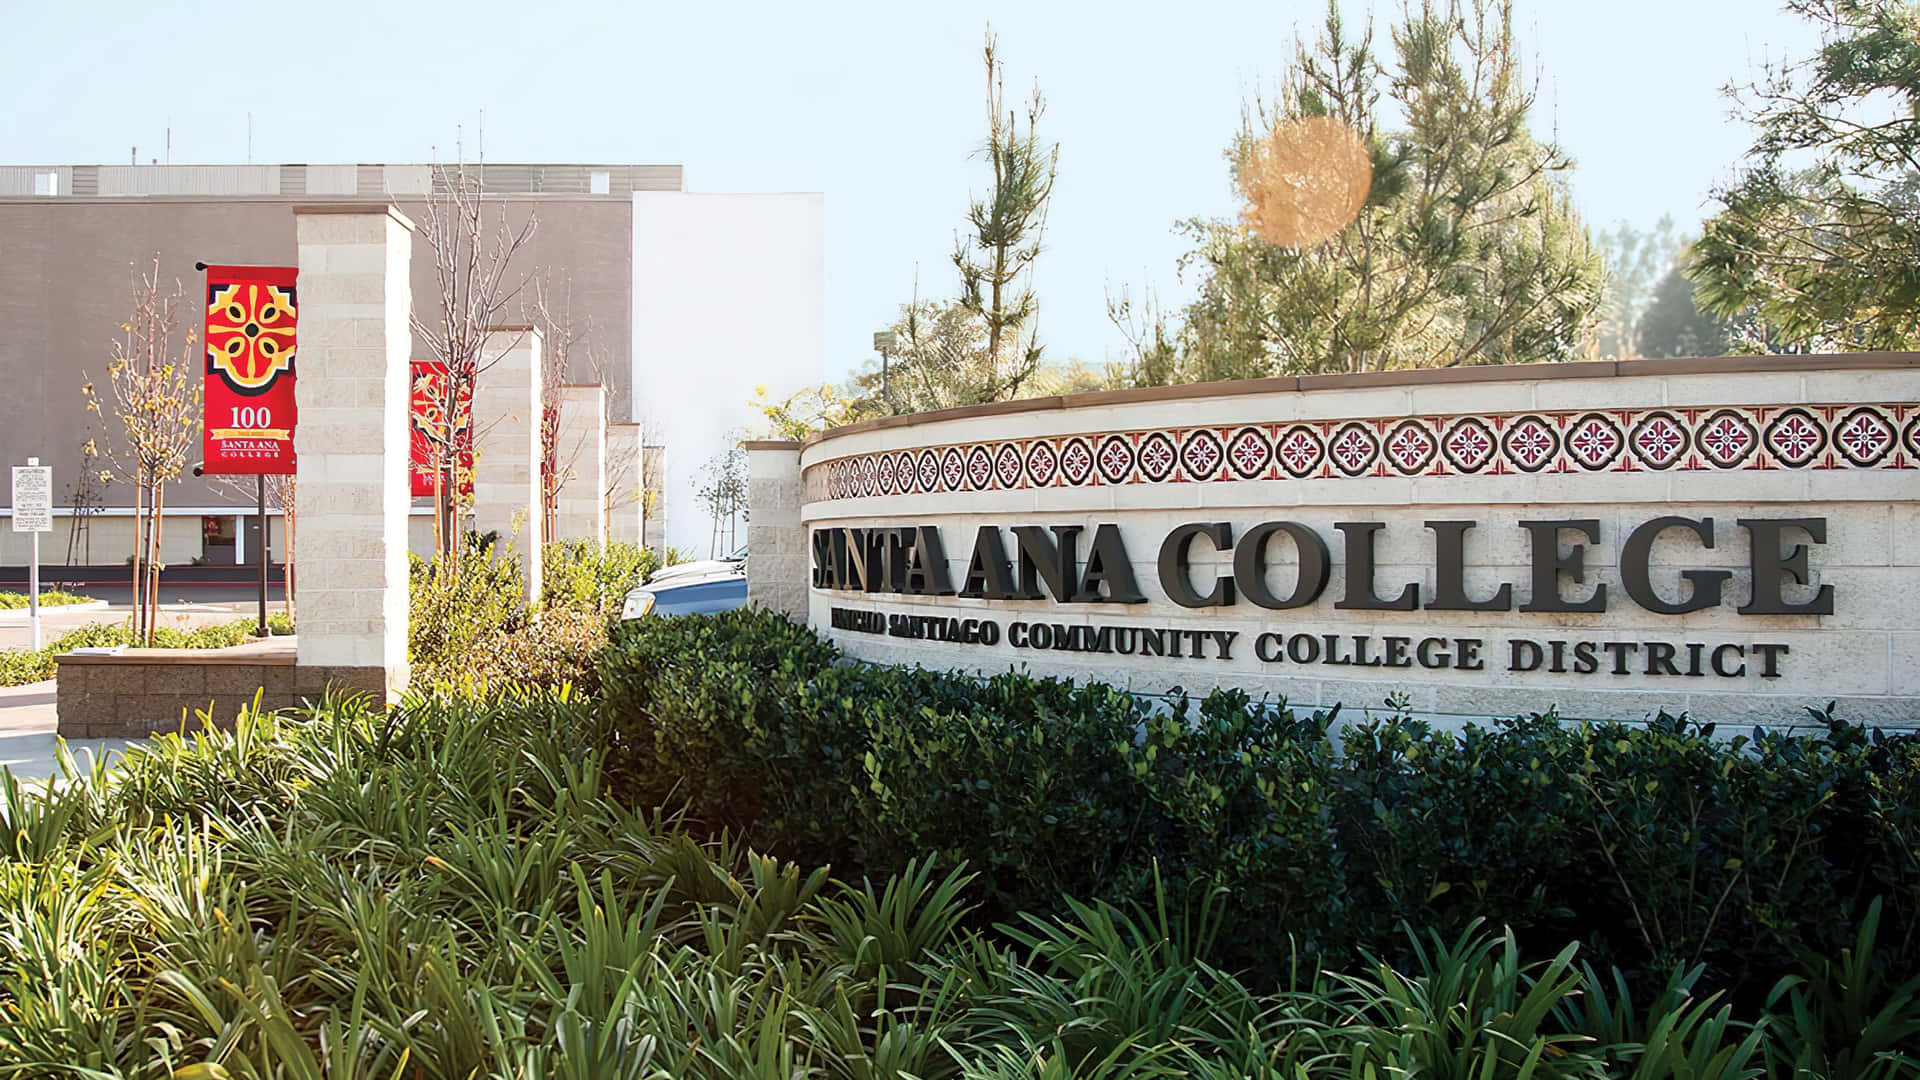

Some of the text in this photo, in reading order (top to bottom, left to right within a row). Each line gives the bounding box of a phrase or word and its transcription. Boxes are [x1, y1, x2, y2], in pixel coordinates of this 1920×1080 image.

[231, 407, 271, 428] 100
[221, 440, 279, 449] SANTA ANA
[812, 516, 1834, 616] SANTA ANA COLLEGE
[889, 614, 1000, 646] SANTIAGO
[1008, 622, 1238, 659] COMMUNITY
[1254, 632, 1484, 670] COLLEGE
[1507, 639, 1790, 677] DISTRICT
